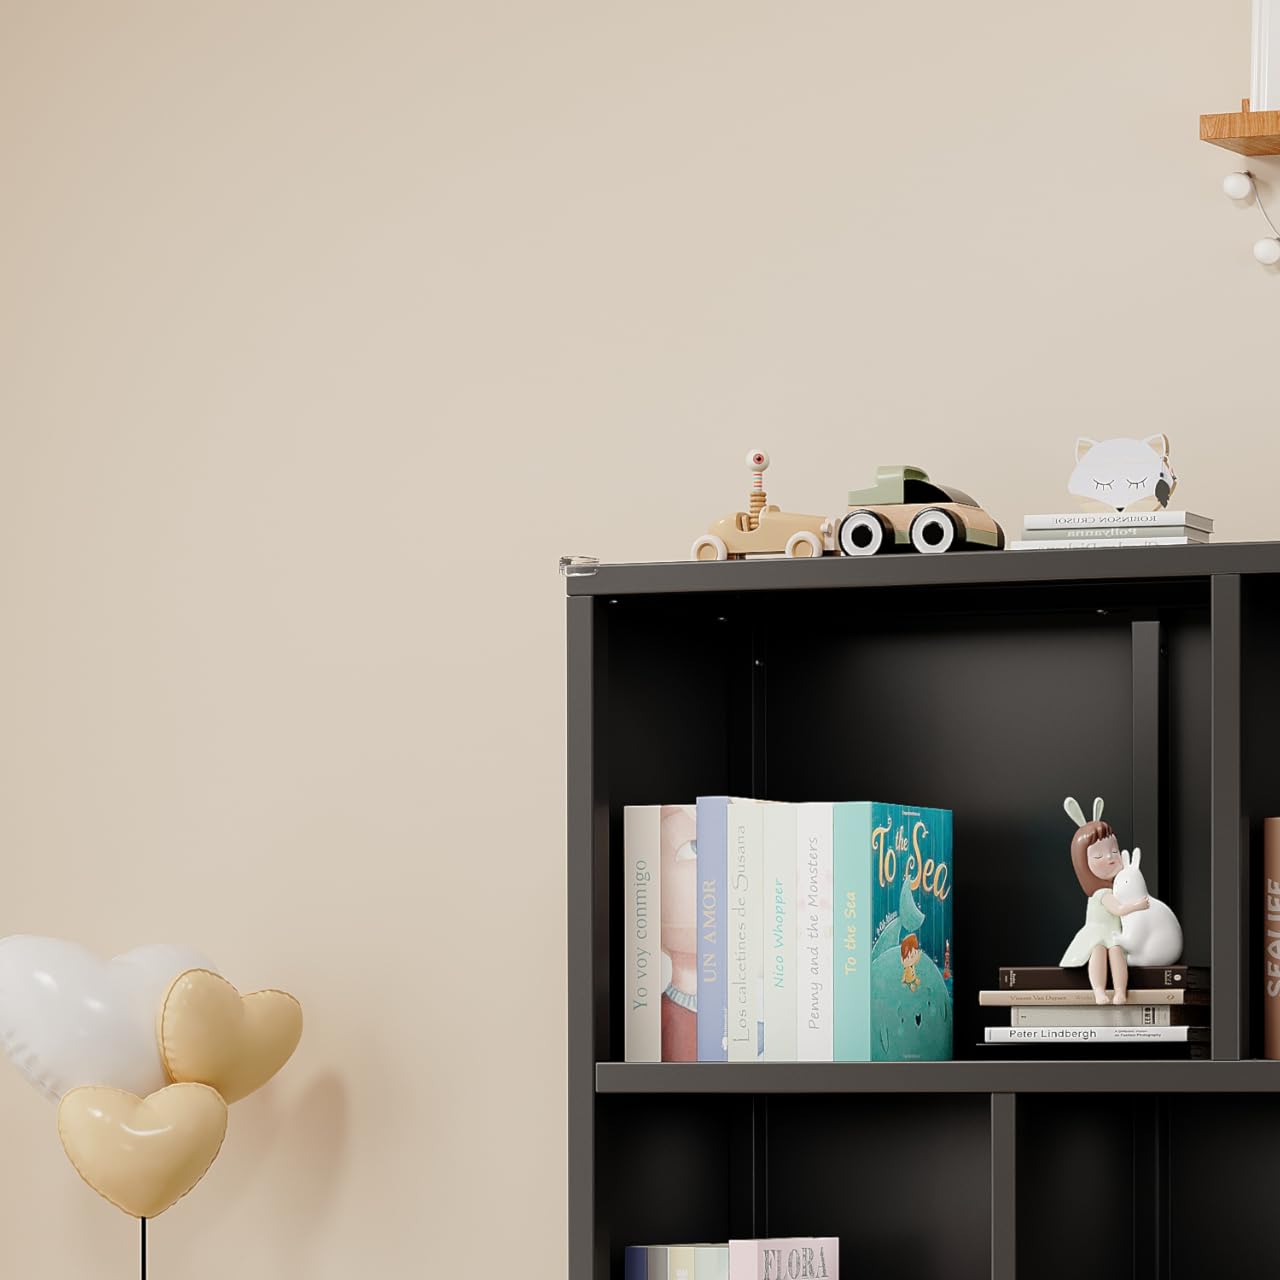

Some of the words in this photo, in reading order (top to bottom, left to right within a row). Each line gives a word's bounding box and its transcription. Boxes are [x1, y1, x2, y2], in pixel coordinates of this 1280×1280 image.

[732, 825, 749, 891] Susana
[808, 836, 819, 907] Monsters
[871, 815, 897, 888] To
[895, 825, 909, 852] the
[903, 820, 952, 901] Sea
[636, 860, 651, 940] conmigo
[703, 879, 717, 944] AMOR
[732, 897, 747, 916] de
[772, 877, 787, 947] Whopper
[845, 891, 858, 918] Sea
[809, 914, 819, 939] the
[845, 925, 858, 953] the
[636, 947, 651, 981] voy
[703, 952, 717, 983] UN
[732, 922, 747, 1005] calcetines
[773, 951, 784, 989] Nico
[810, 946, 819, 978] and
[844, 955, 858, 976] To
[633, 987, 648, 1011] Yo
[808, 981, 823, 1030] Penny
[733, 1008, 750, 1043] Los
[1009, 1029, 1038, 1039] Peter
[1040, 1029, 1097, 1041] Lindbergh
[762, 1246, 829, 1280] FLORA
